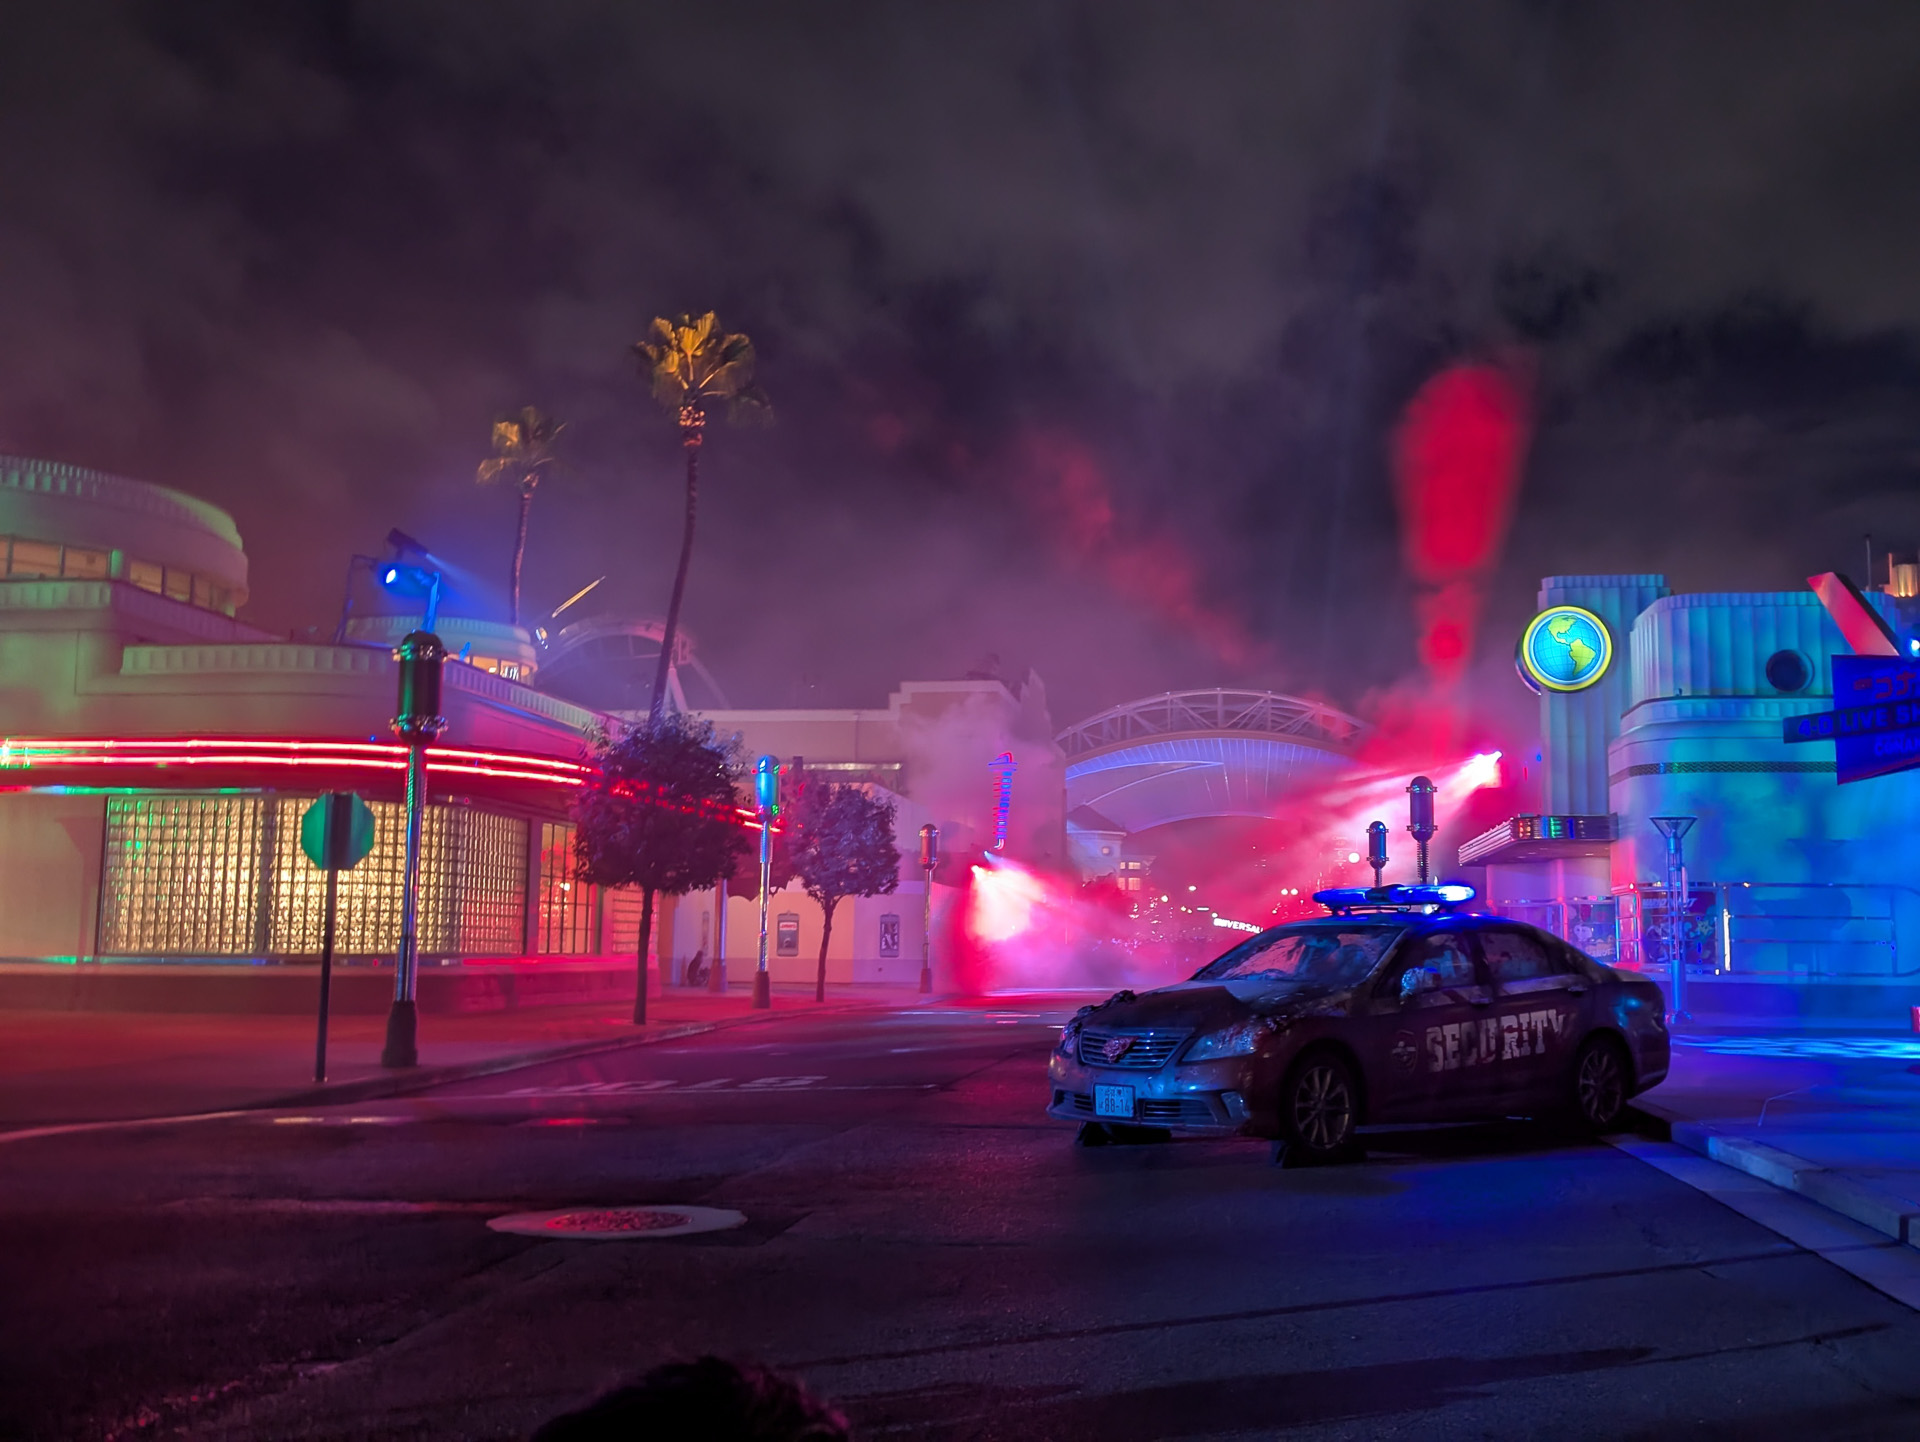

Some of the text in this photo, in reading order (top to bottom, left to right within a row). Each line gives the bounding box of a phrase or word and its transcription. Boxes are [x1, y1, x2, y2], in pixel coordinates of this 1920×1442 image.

[1798, 714, 1834, 737] 4-D
[1839, 707, 1888, 733] LIVE
[1426, 1008, 1567, 1073] SECURITY
